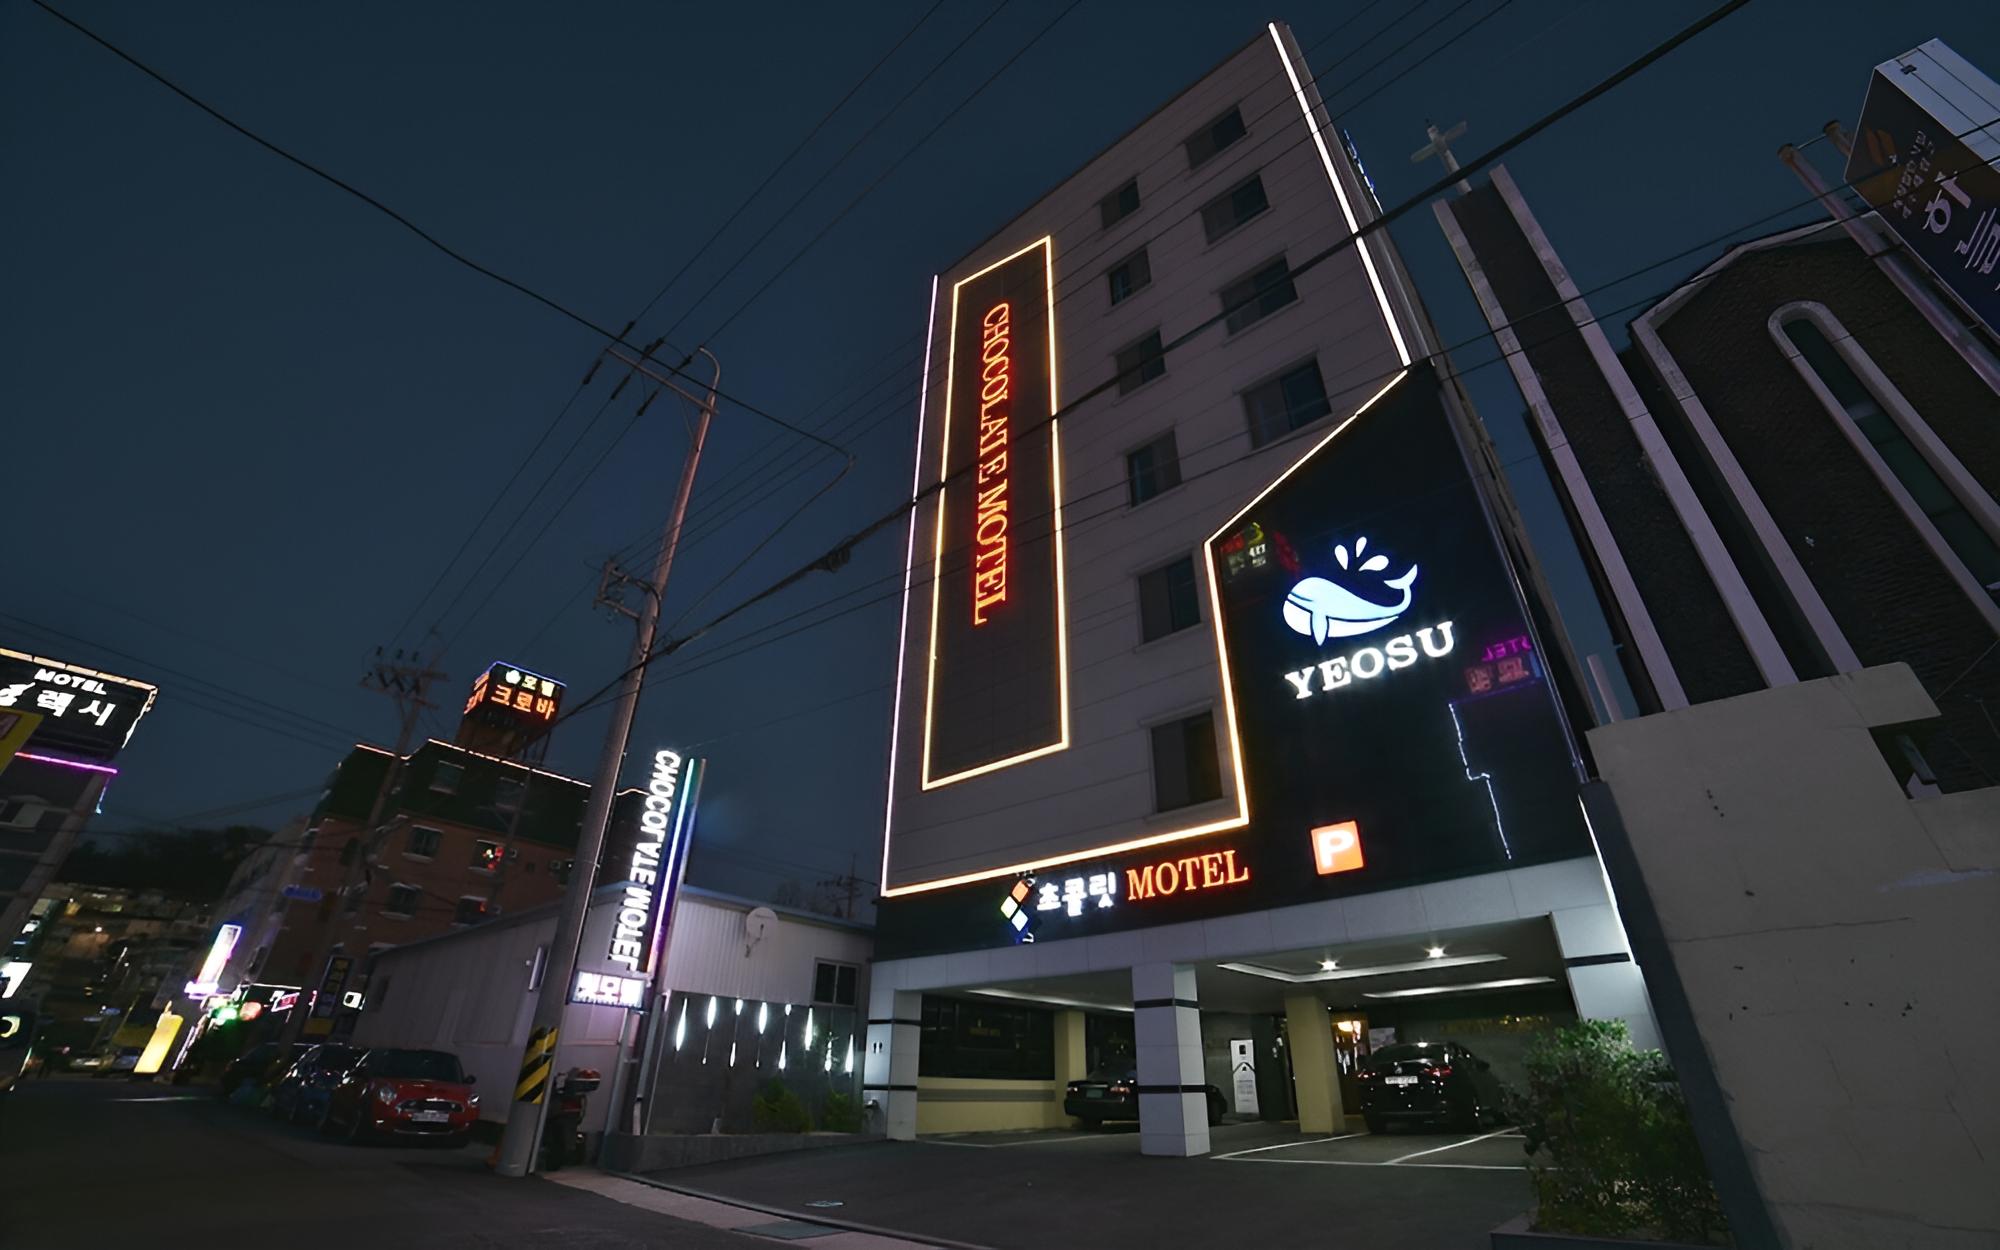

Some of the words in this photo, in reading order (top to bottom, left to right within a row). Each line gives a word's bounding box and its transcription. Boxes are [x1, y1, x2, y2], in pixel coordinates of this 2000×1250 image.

[977, 302, 1011, 485] CHOCOLATE
[973, 484, 1010, 626] MOTEL
[34, 668, 107, 695] MOTEL
[1283, 620, 1456, 701] YEOSU
[491, 684, 555, 720] 크로바
[1325, 830, 1356, 868] P
[1036, 871, 1118, 917] 초콜릿
[1125, 849, 1250, 902] MOTEL
